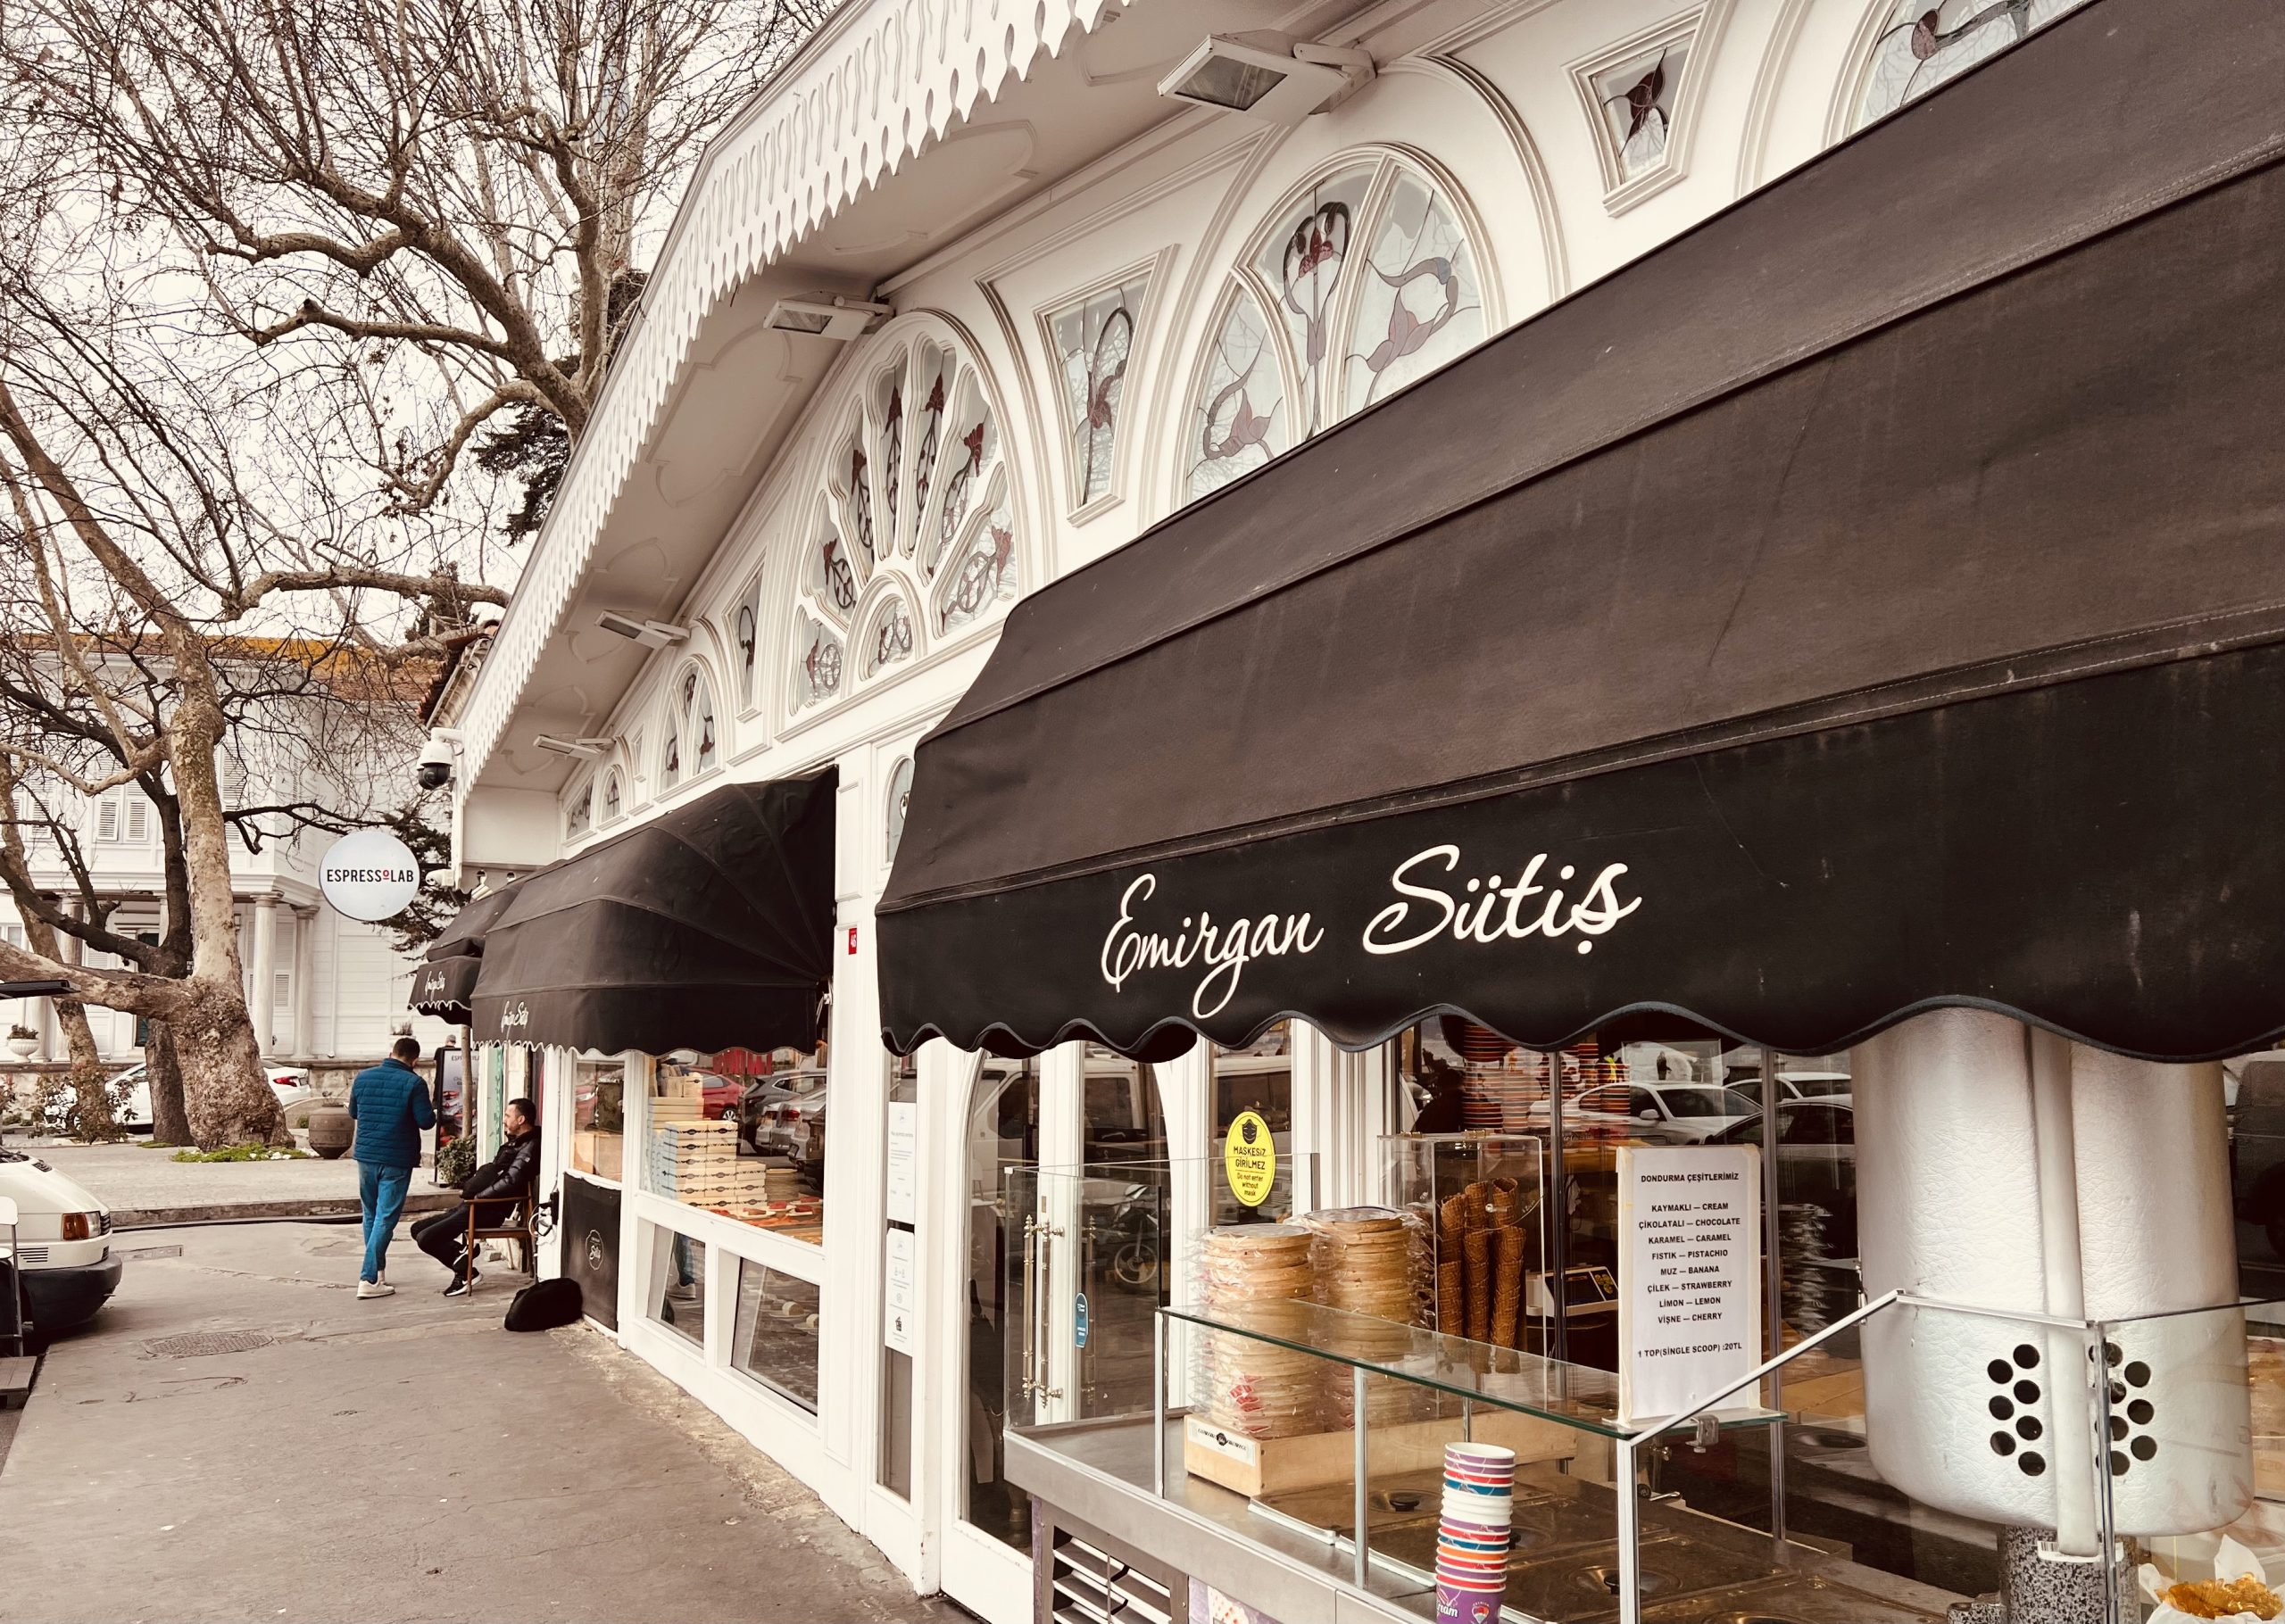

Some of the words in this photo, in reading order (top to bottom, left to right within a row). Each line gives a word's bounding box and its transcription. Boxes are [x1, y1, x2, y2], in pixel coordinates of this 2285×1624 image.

[1101, 873, 1324, 1019] Emirgan
[1362, 843, 1643, 956] Sütiş
[1641, 1174, 1685, 1182] DONDURMA
[1687, 1172, 1740, 1183] ÇEŞİTLERİMİZ
[1651, 1204, 1691, 1212] KAYMAKLI
[1702, 1203, 1729, 1211] CREAM
[1639, 1220, 1684, 1230] ÇİKOLATALI
[1695, 1217, 1741, 1226] CHOCOLATE
[1648, 1236, 1685, 1244] KARAMEL
[1696, 1233, 1732, 1242] CARAMEL
[1651, 1252, 1677, 1260] FISTIK
[1688, 1249, 1728, 1258] PISTACHIO
[1688, 1265, 1720, 1274] BANANA
[1647, 1283, 1670, 1294] ÇİLEK
[1681, 1280, 1732, 1290] STRAWBERRY
[1659, 1299, 1684, 1308] LİMON
[1694, 1297, 1721, 1305] LEMON
[1658, 1314, 1682, 1324] VİŞNE
[1691, 1313, 1723, 1322] CHERRY
[1692, 1344, 1721, 1354] SCOOP)
